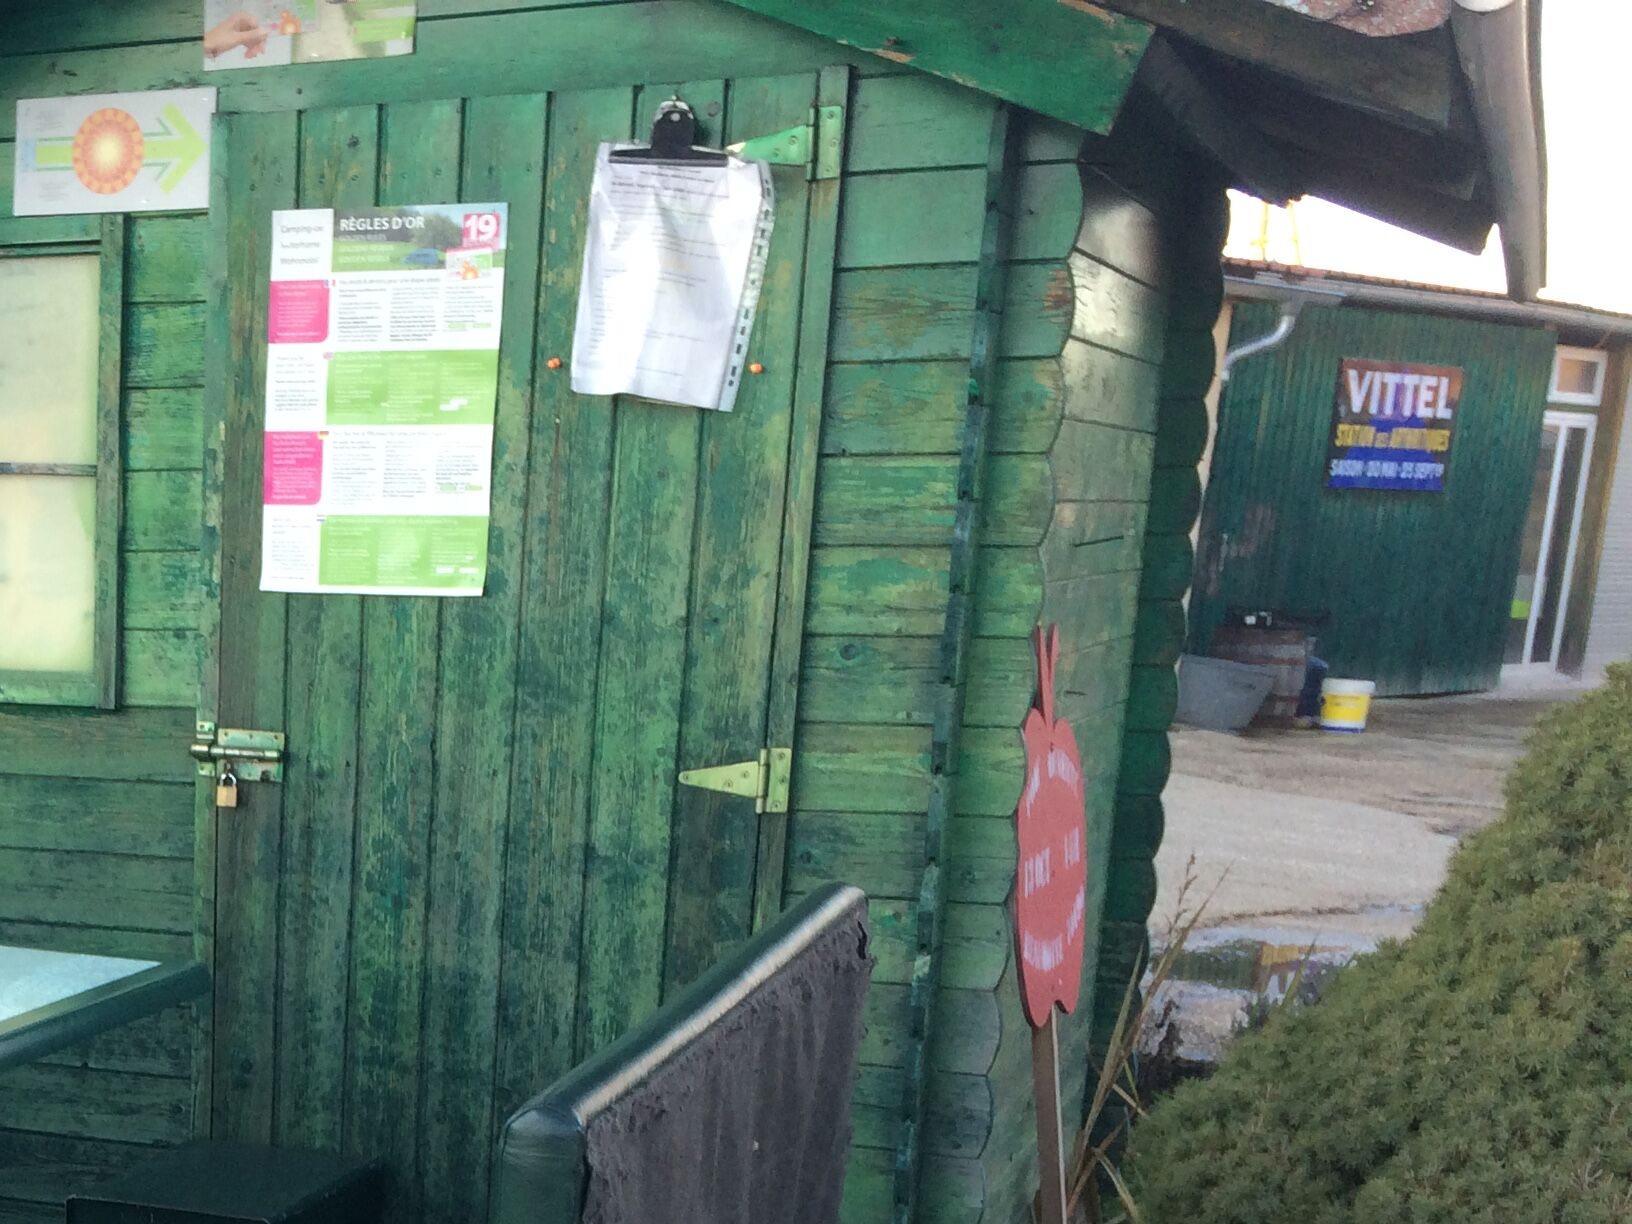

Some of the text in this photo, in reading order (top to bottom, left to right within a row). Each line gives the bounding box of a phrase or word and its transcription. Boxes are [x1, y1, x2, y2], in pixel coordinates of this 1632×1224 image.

[339, 216, 425, 231] RÈGLES D'OR
[464, 214, 497, 241] 19
[1348, 369, 1452, 419] VITTEL
